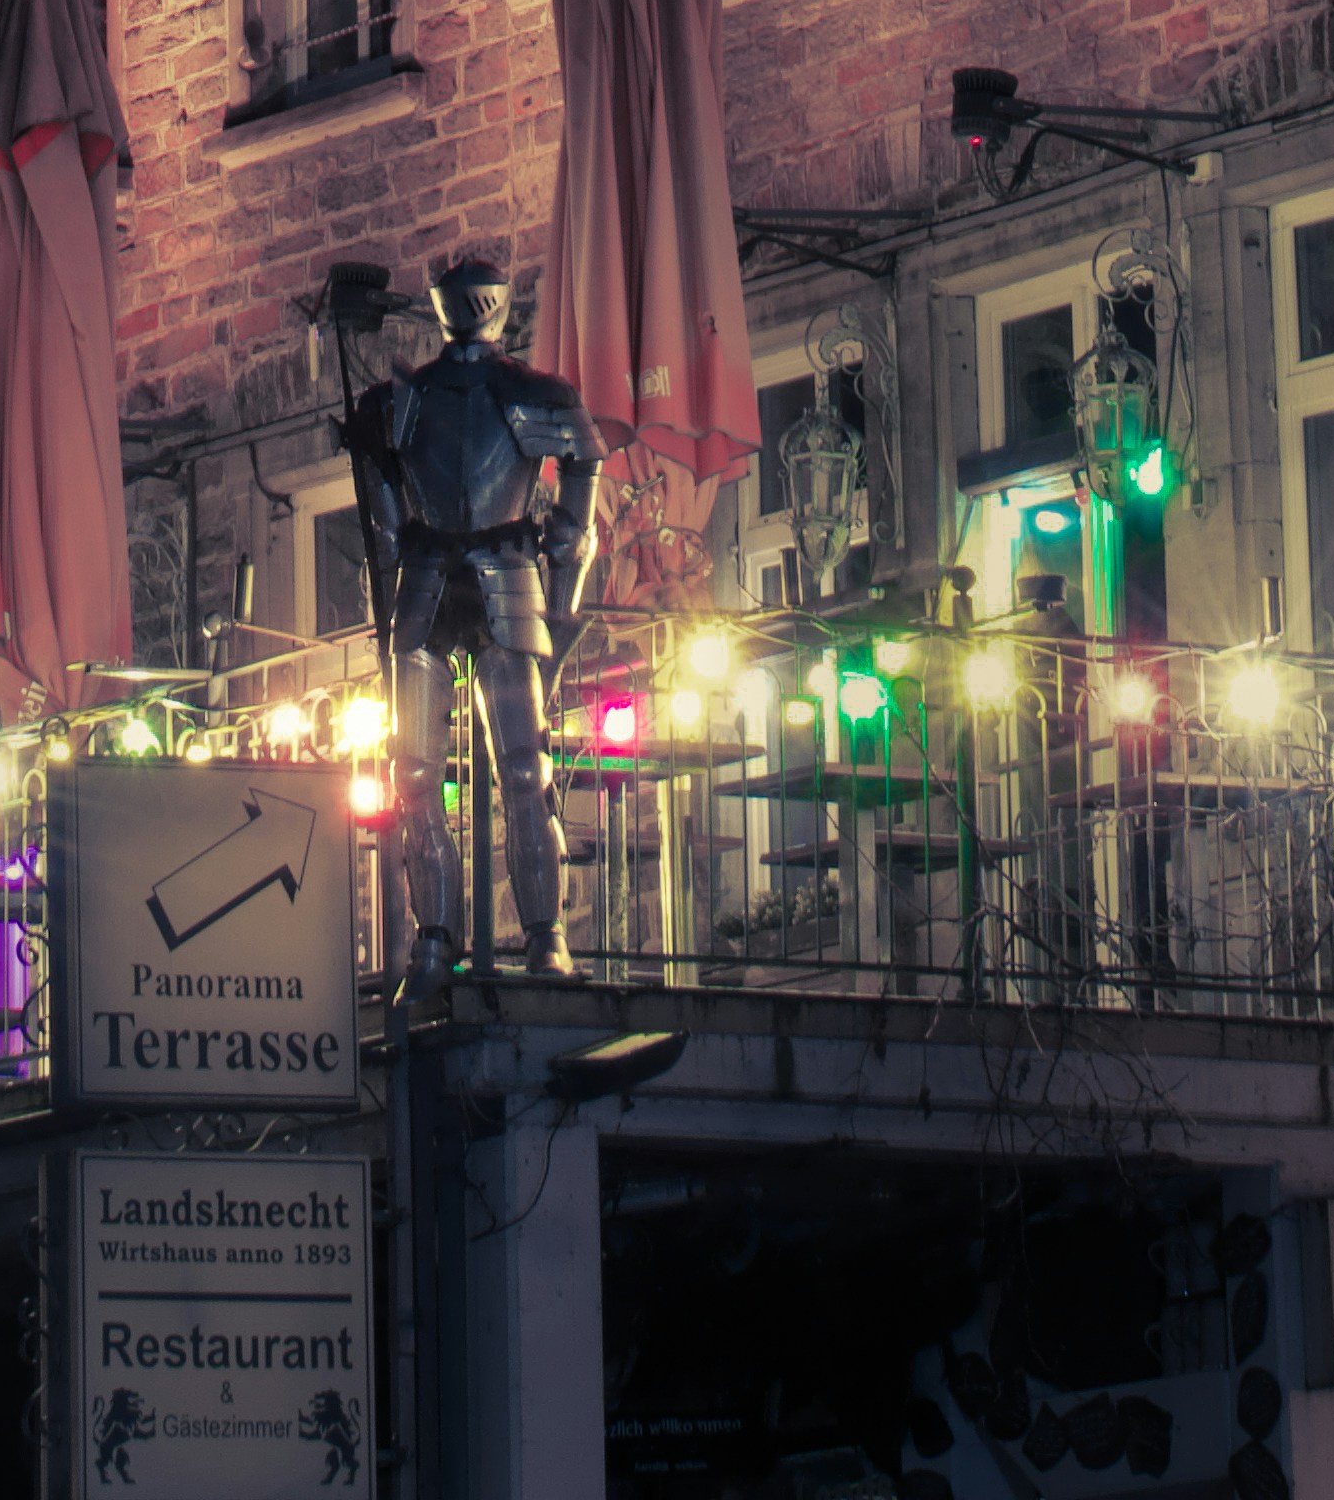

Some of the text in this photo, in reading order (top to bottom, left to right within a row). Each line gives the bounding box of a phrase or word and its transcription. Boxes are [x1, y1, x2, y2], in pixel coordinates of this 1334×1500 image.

[131, 963, 304, 1000] Panorama
[92, 1011, 340, 1073] Terrasse
[99, 1188, 350, 1229] Landsknecht
[98, 1240, 353, 1267] Wirtshaus anno 1893
[101, 1322, 354, 1371] Restaurant
[220, 1380, 234, 1404] &
[162, 1414, 293, 1439] Gästezimmer
